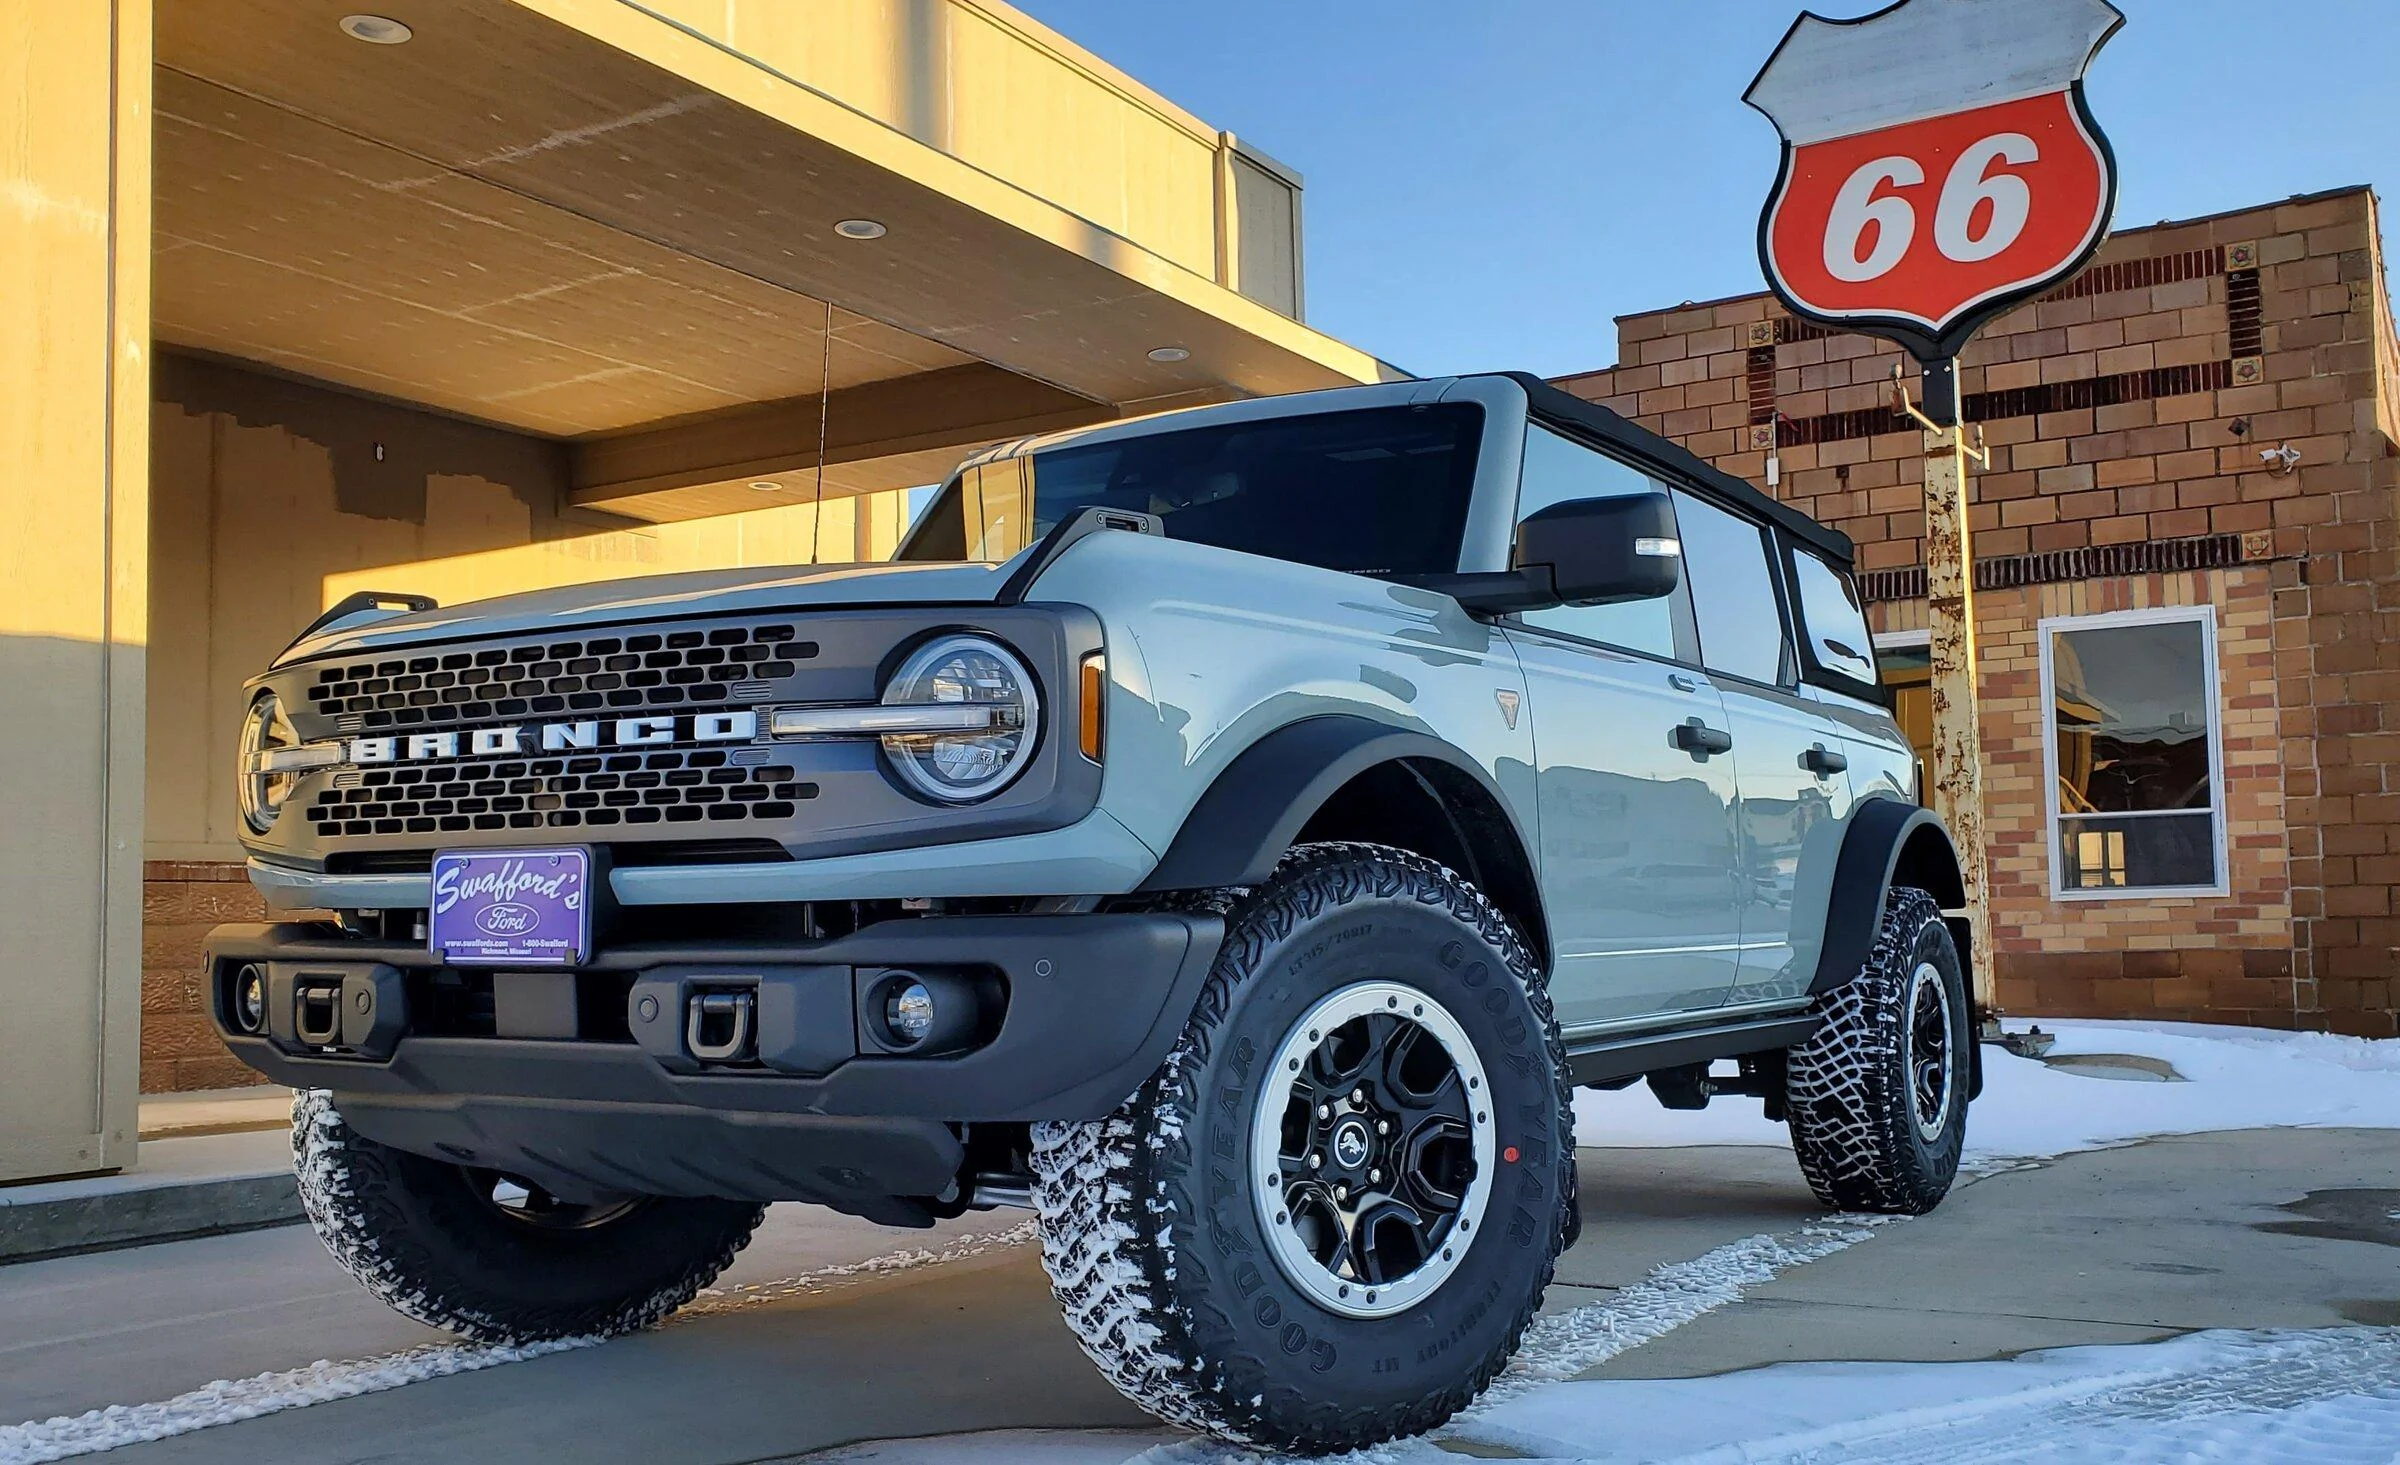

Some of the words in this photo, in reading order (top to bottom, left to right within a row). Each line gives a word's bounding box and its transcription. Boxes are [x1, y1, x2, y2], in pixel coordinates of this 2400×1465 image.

[1822, 132, 2039, 282] 66
[350, 711, 757, 764] BRONCO
[436, 860, 580, 914] Swafford's
[487, 906, 527, 930] Ford
[1437, 939, 1549, 1248] GOODYEAR
[1209, 1036, 1337, 1374] GOODYEAR
